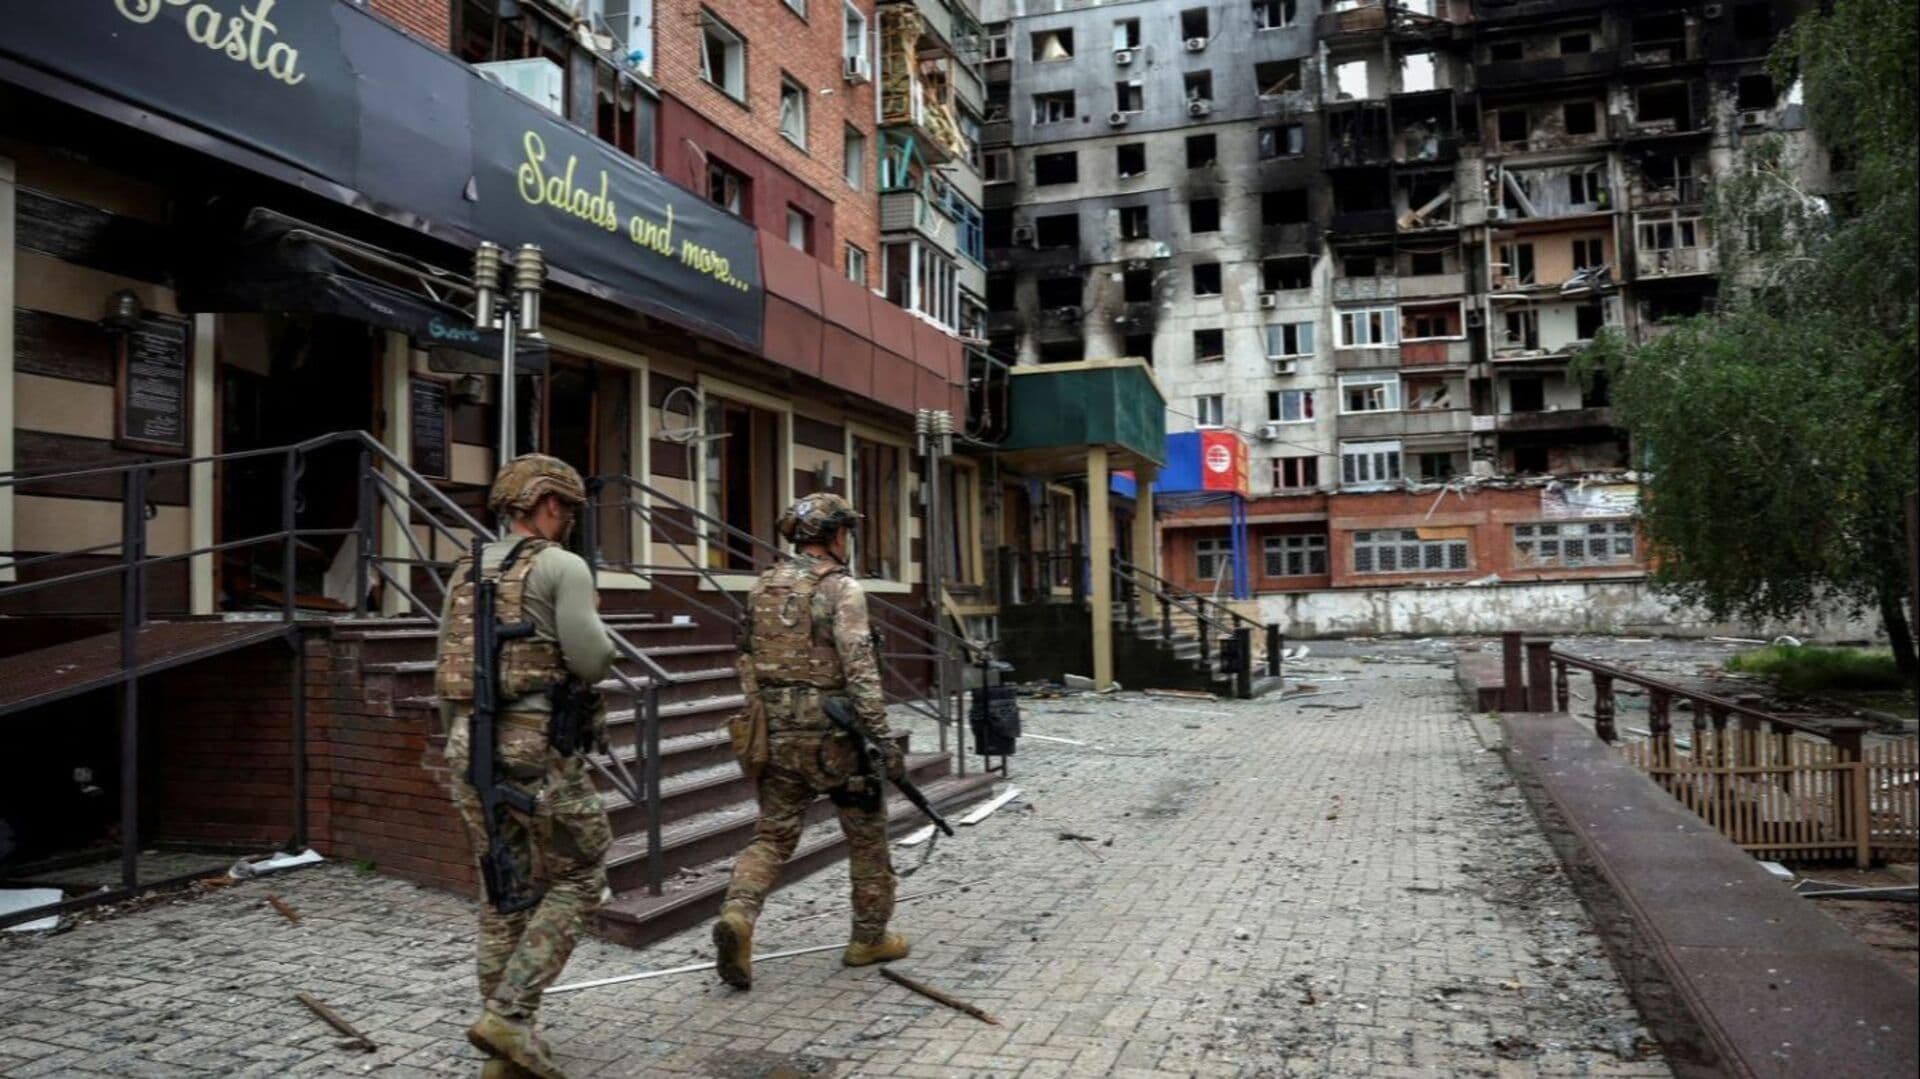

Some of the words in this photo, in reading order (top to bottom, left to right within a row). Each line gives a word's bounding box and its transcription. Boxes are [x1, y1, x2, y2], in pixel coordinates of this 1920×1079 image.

[114, 0, 305, 86] asta
[518, 130, 617, 232] Salads
[629, 203, 675, 256] and
[681, 239, 748, 292] more...
